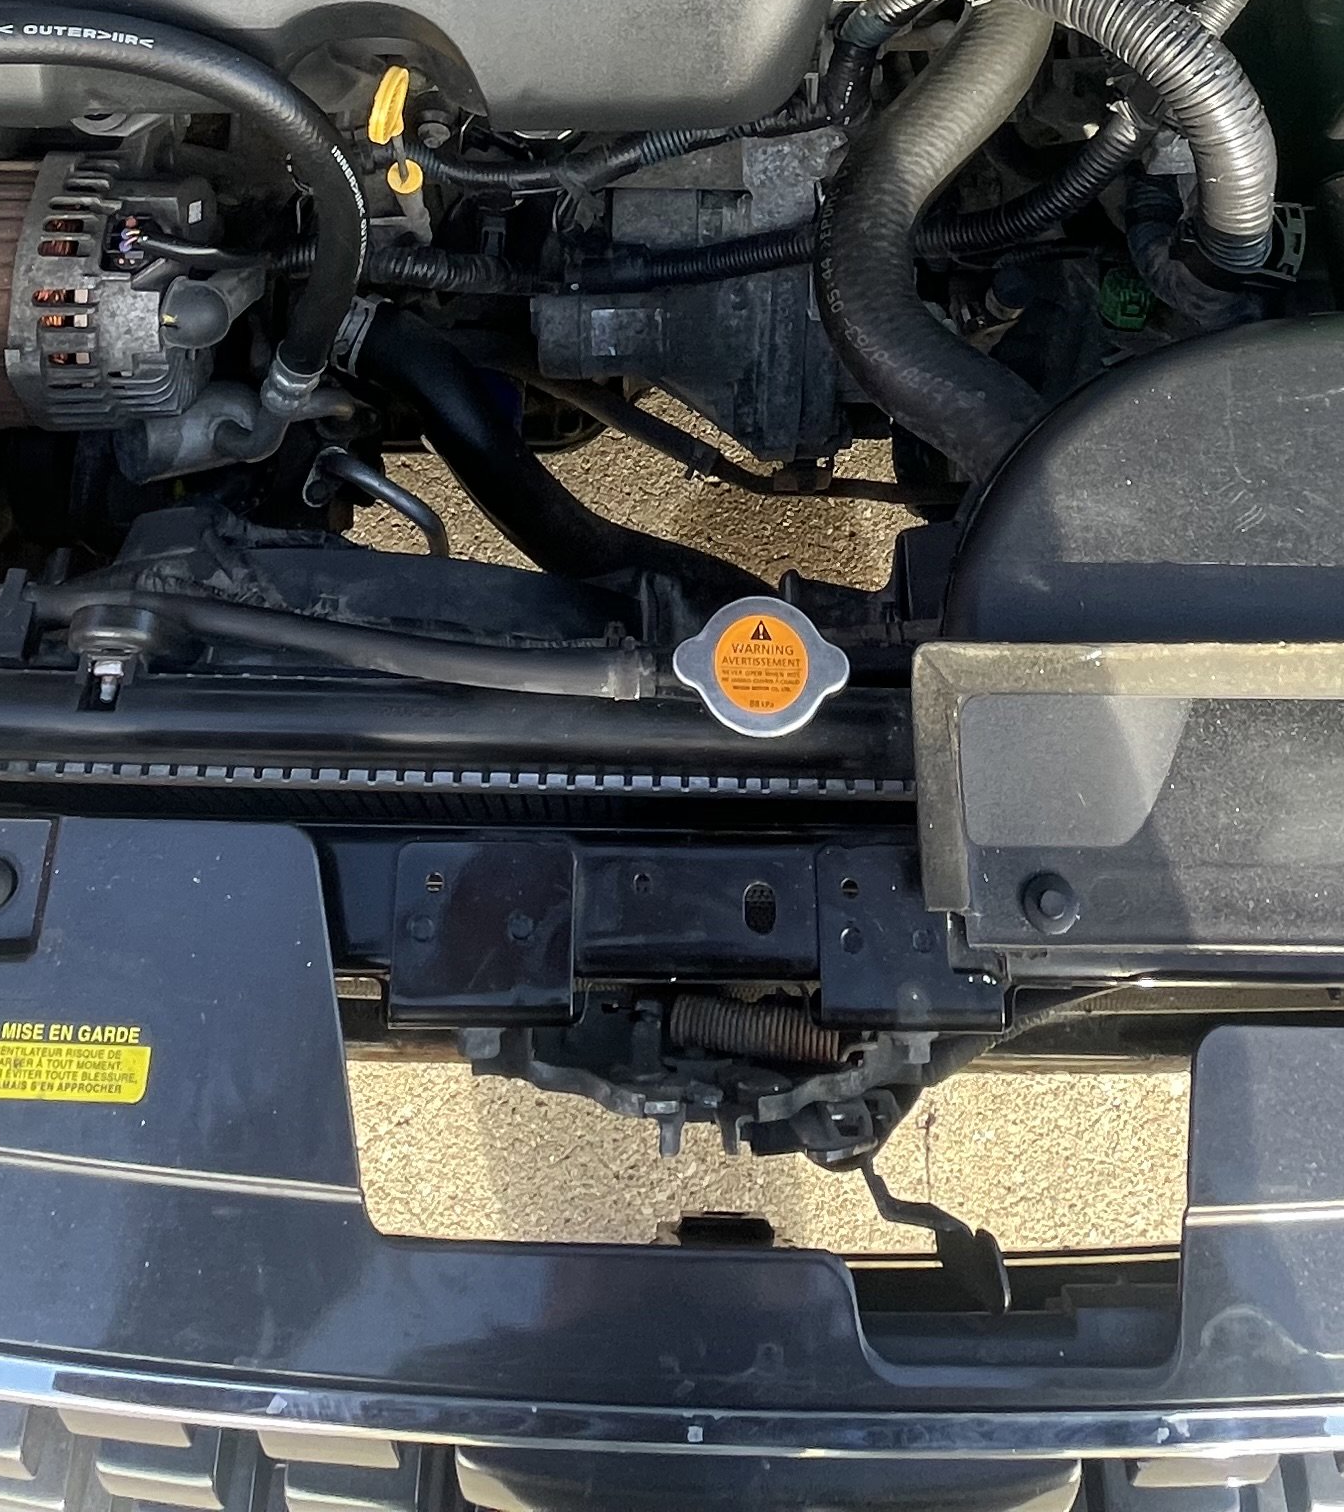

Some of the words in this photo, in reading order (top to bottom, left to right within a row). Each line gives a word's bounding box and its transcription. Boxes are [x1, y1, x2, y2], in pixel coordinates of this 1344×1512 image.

[731, 643, 794, 656] WARNING
[721, 656, 801, 667] AVERTISSEMENT
[1, 1022, 45, 1040] MISE
[49, 1024, 74, 1041] EN
[78, 1025, 141, 1044] GARDE
[65, 1047, 104, 1060] RISQUE
[107, 1049, 122, 1059] DE
[47, 1059, 73, 1070] TOUT
[45, 1070, 78, 1081] TOUTE
[56, 1082, 122, 1094] APPROCHER
